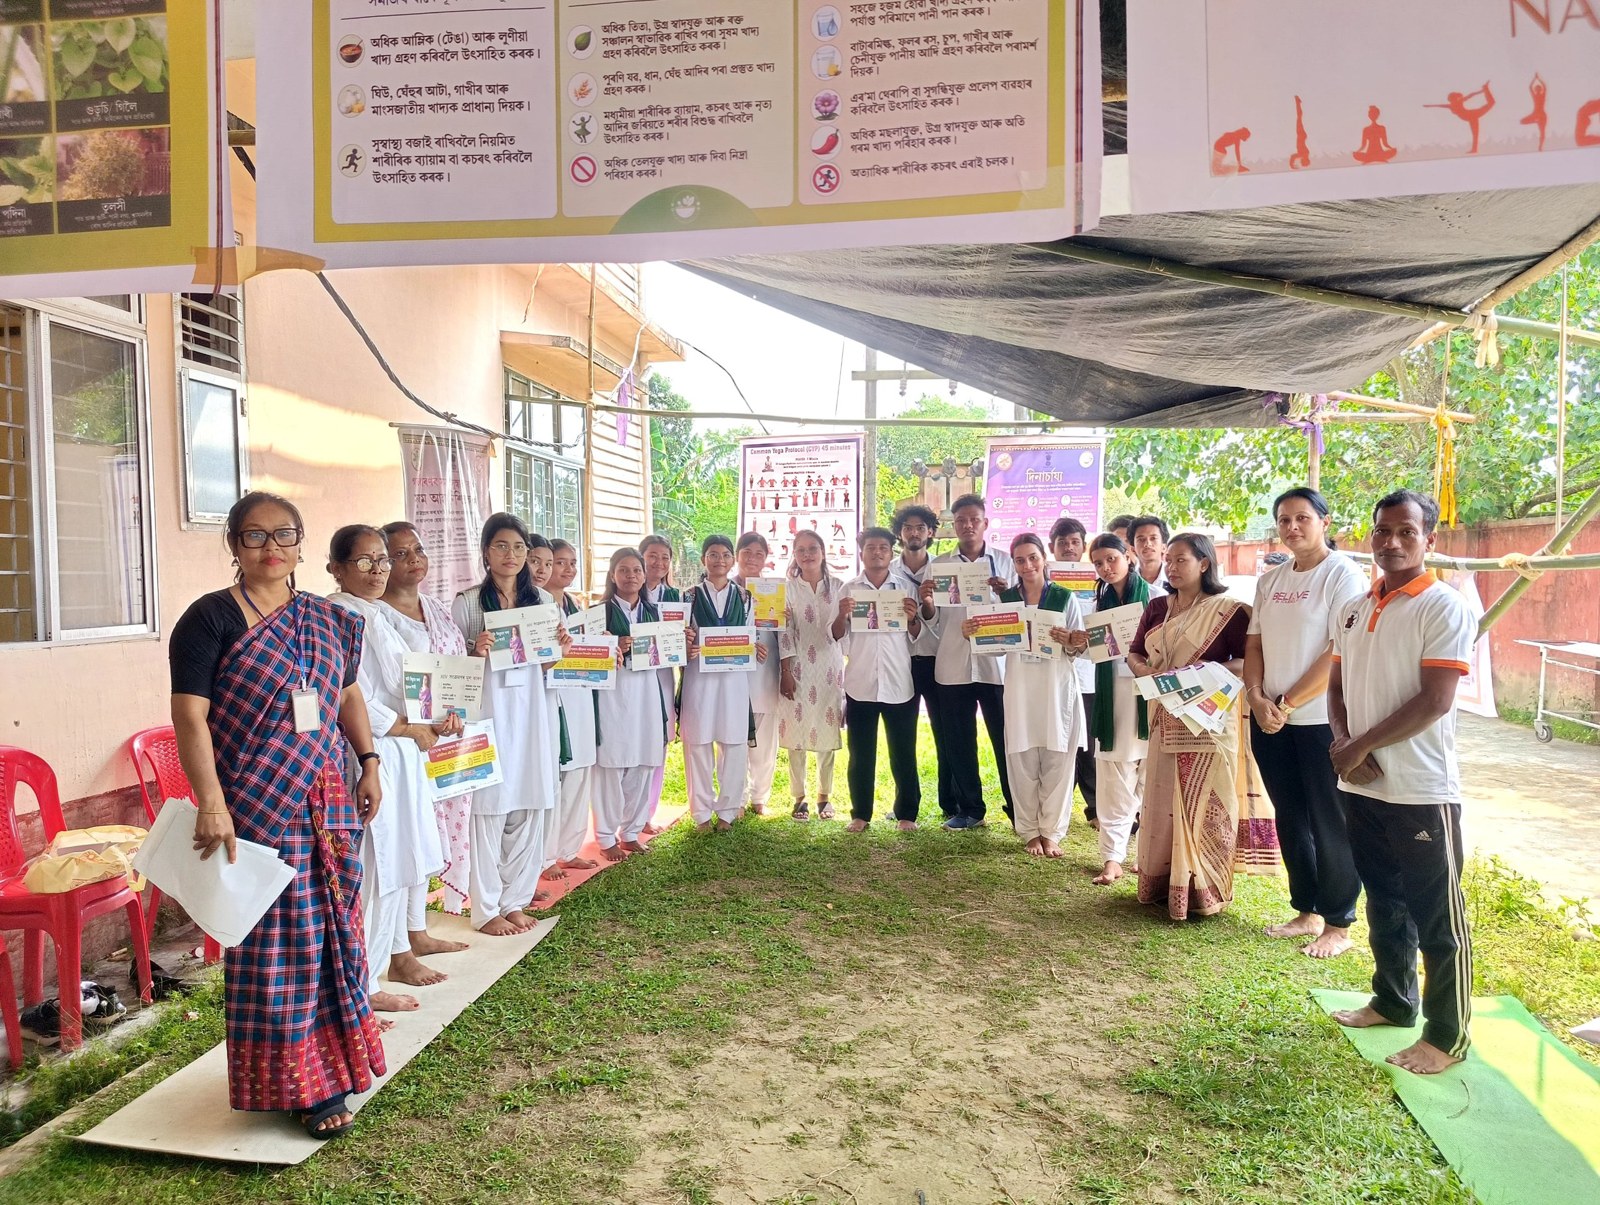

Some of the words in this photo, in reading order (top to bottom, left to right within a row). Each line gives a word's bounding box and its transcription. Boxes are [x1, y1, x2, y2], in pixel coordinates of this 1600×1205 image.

[918, 7, 938, 20] পানী
[941, 9, 958, 18] পান
[601, 22, 626, 33] অধিক
[370, 34, 399, 48] অধিক
[472, 32, 495, 42] আৰু
[700, 30, 716, 38] পৰা
[660, 41, 696, 54] উৎসাহিত
[371, 54, 391, 65] খাদ্য
[419, 48, 458, 62] কৰিবলৈ
[461, 46, 505, 61] উৎসাহিত
[683, 65, 709, 76] আদিৰ
[711, 65, 727, 75] পৰা
[454, 81, 482, 95] গাখীৰ
[485, 84, 509, 94] আৰু
[912, 87, 920, 96] বা
[604, 119, 628, 131] আদিৰ
[850, 128, 876, 139] অধিক
[405, 135, 432, 149] বজাই
[434, 134, 476, 148] ৰাখিবলৈ
[479, 133, 515, 147] নিয়মিত
[372, 153, 412, 166] শাৰীৰিক
[448, 154, 458, 165] বা
[493, 150, 532, 163] কৰিবলৈ
[604, 156, 628, 167] অধিক
[372, 170, 416, 184] উৎসাহিত
[1272, 590, 1311, 601] BELIVE
